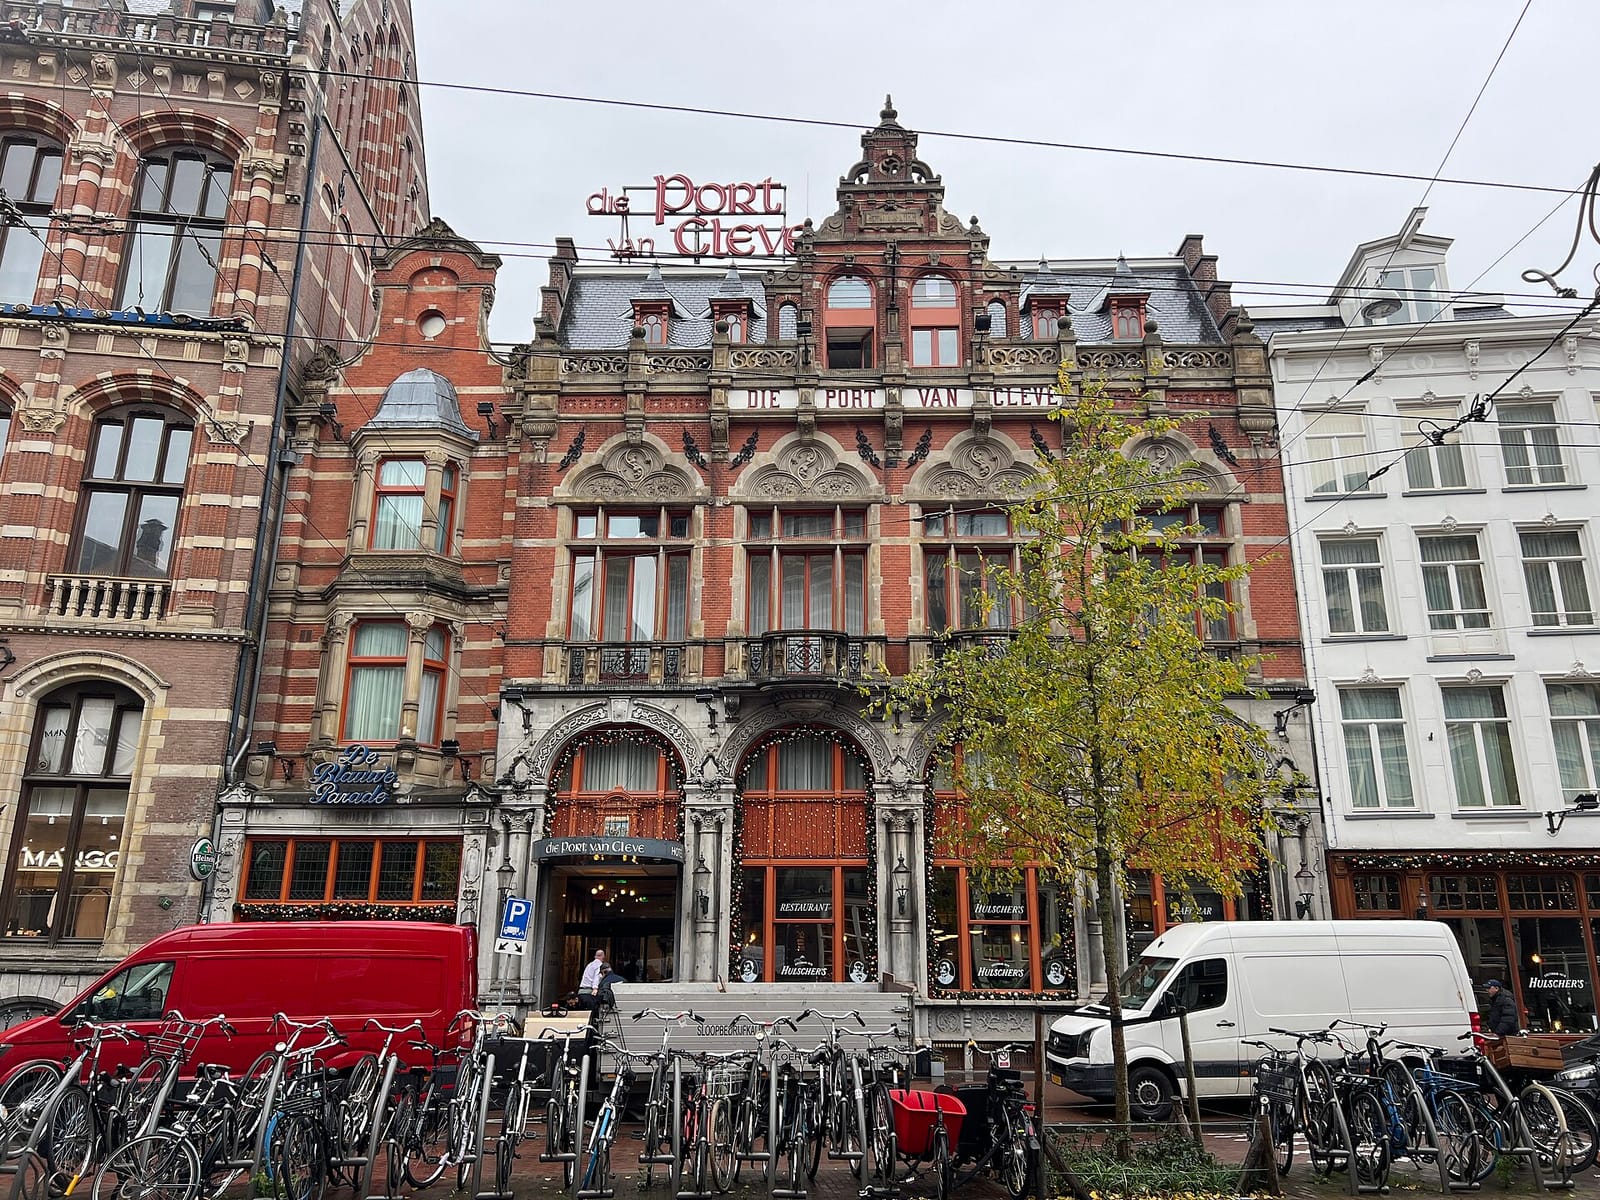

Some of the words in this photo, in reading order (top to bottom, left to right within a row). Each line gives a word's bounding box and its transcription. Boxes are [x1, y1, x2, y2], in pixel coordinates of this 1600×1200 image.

[586, 187, 630, 213] die
[607, 237, 654, 256] van
[747, 390, 781, 408] DIE
[825, 390, 876, 408] PORT
[918, 389, 959, 407] VAN
[993, 387, 1058, 406] CLEVE
[339, 743, 379, 765] De
[308, 762, 398, 785] Blauwe
[309, 783, 390, 804] Parade
[545, 841, 559, 853] die
[590, 842, 610, 853] van
[611, 840, 645, 853] Cleve
[509, 902, 526, 922] P
[780, 903, 831, 912] RESTAURANT
[1528, 977, 1585, 988] HULSCHER'S
